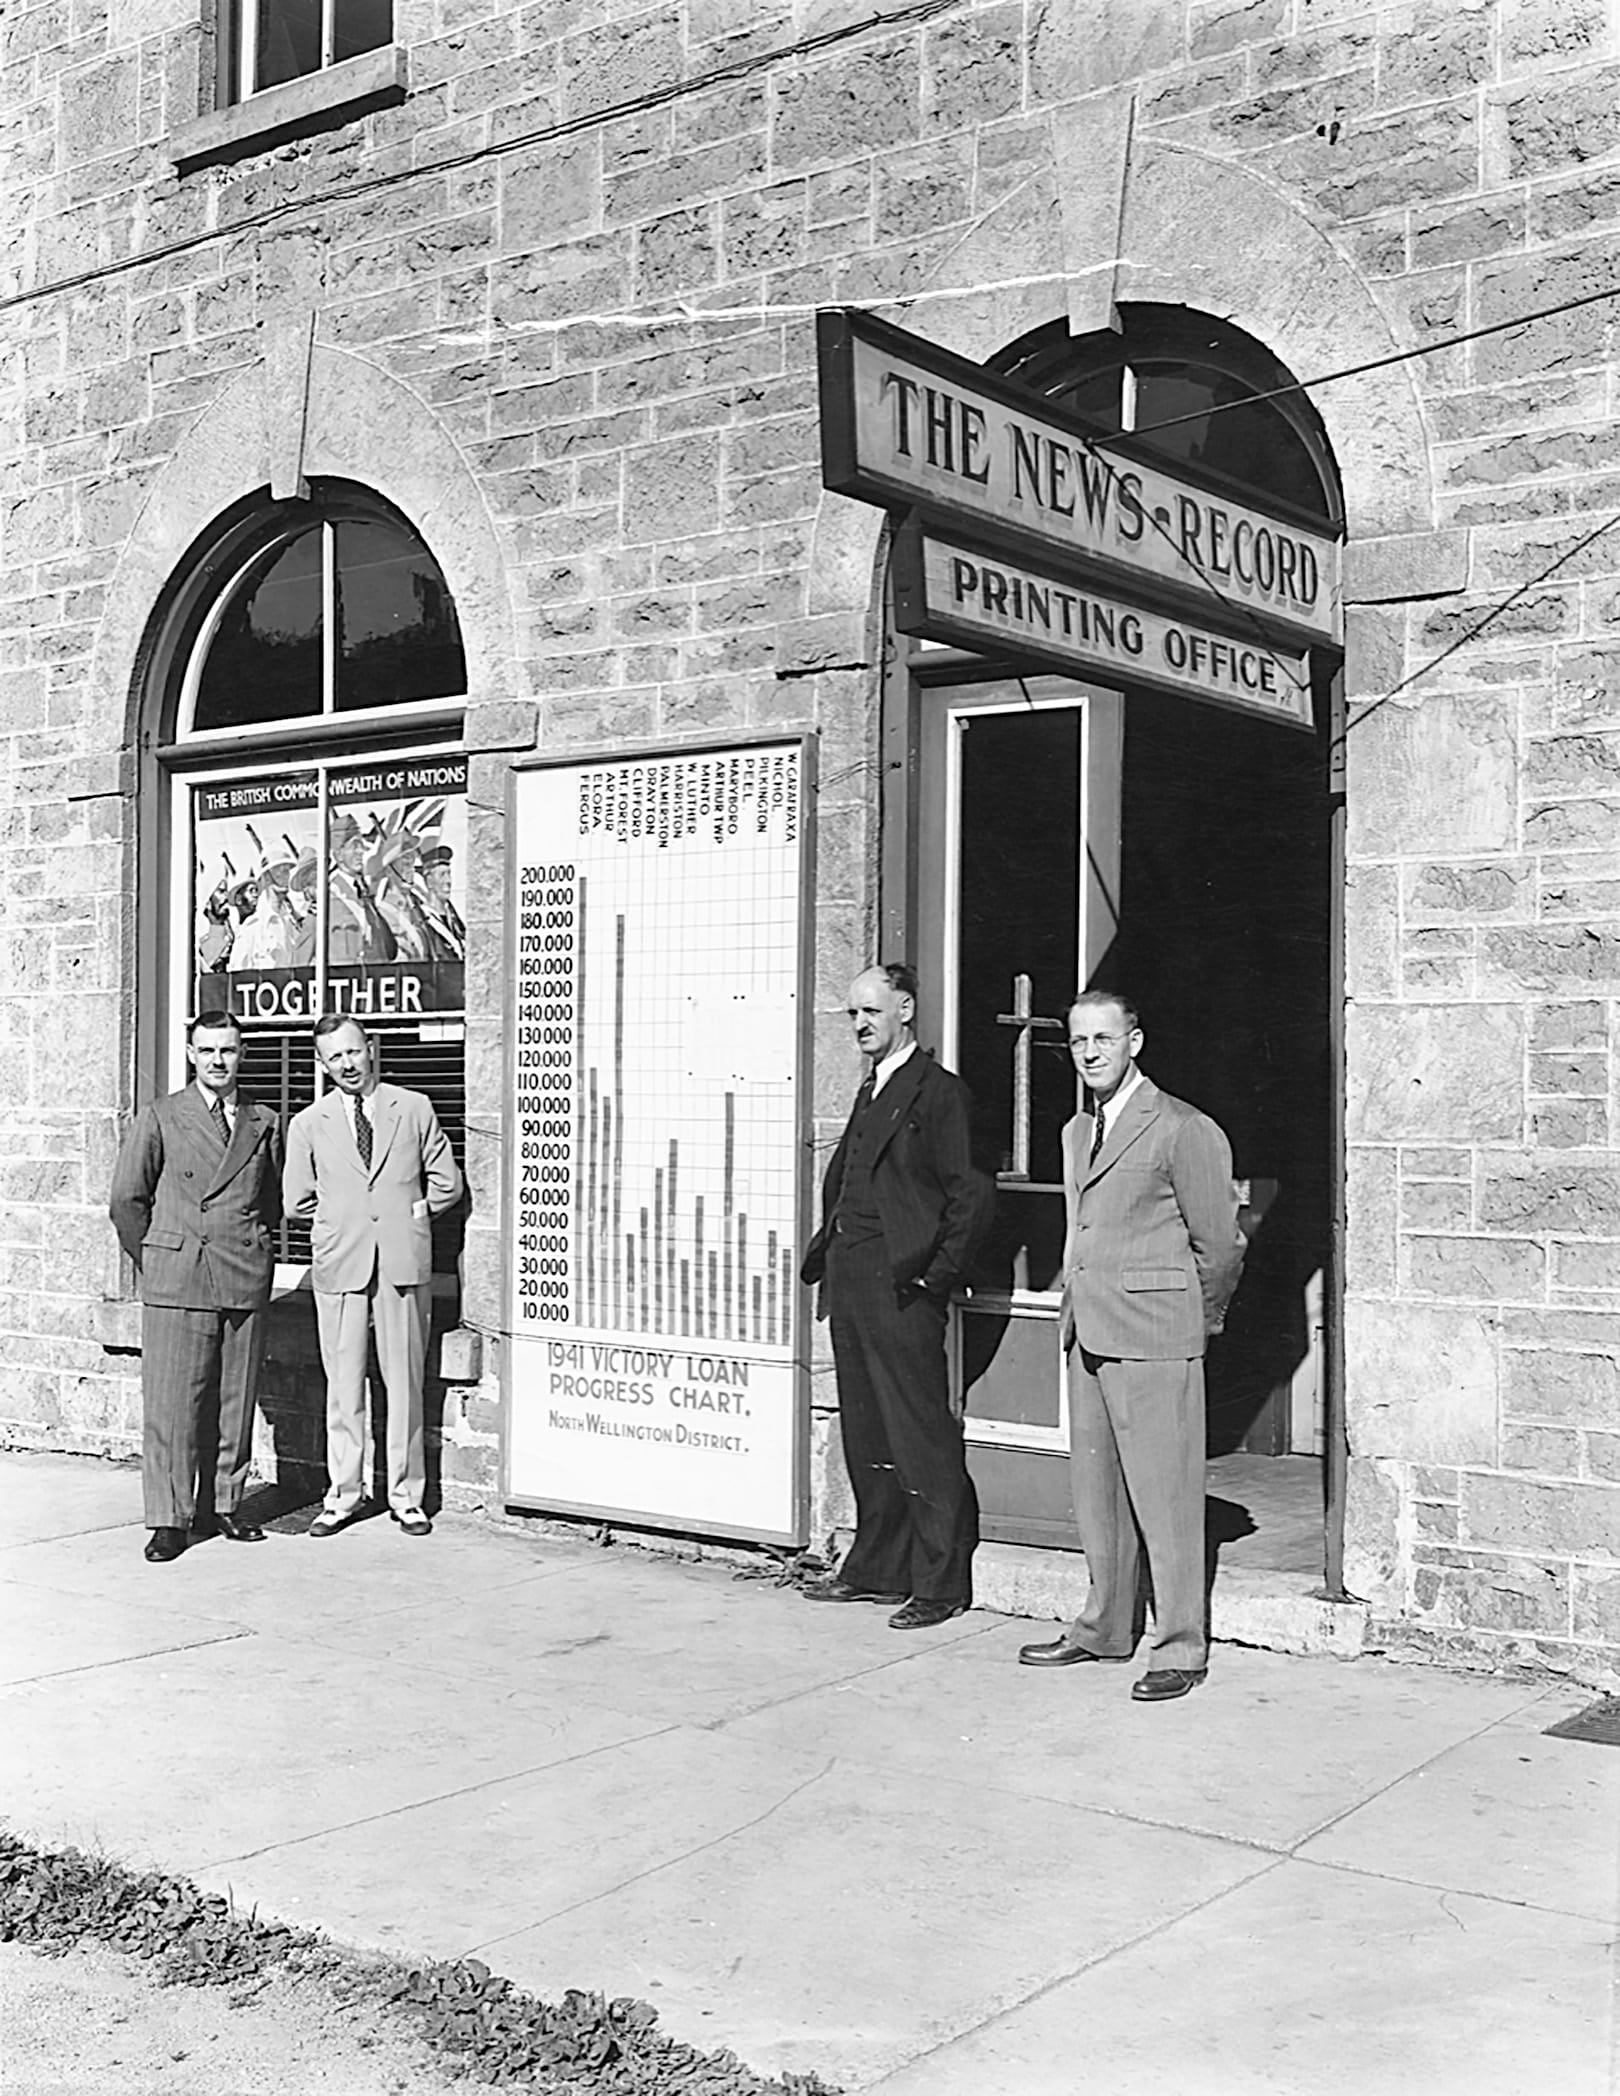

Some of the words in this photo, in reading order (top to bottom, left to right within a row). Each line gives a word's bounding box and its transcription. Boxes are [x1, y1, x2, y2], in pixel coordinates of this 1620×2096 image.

[880, 371, 990, 486] THE
[953, 557, 1144, 655] PRINTING
[1164, 628, 1278, 695] OFFICE
[206, 792, 229, 810] THE
[230, 787, 271, 807] BRITISH
[386, 772, 405, 790] OF
[407, 765, 466, 788] NATIONS
[699, 763, 711, 816] MINTO
[713, 760, 726, 813] ARTHUR
[727, 758, 740, 835] MARYBORO
[757, 756, 769, 833] PILKINGTON
[579, 774, 590, 835] FERGUS
[592, 773, 603, 829] ELORA
[604, 772, 616, 832] ARTHUR
[631, 767, 644, 838] CLIFFORD
[645, 767, 657, 835] DRAYTON
[658, 765, 671, 849] PALMERSTON
[672, 764, 684, 839] HARRISTON
[685, 779, 698, 835] LUTHER
[785, 767, 798, 842] GARAFRAXA
[713, 815, 725, 845] TWP
[520, 864, 575, 885] 200.000
[521, 887, 574, 908] 190.000
[520, 910, 574, 930] 180.000
[520, 933, 574, 953] 170.000
[519, 956, 574, 976] 160.000
[235, 975, 423, 1016] TOGETHER
[519, 980, 573, 999] 150.000
[518, 1003, 573, 1022] 140.000
[518, 1026, 573, 1045] 130.000
[518, 1049, 572, 1068] 120.000
[517, 1072, 572, 1091] 110.000
[517, 1095, 571, 1115] 100.000
[521, 1119, 571, 1138] 90.000
[521, 1141, 571, 1161] 80.000
[521, 1164, 570, 1184] 70.000
[519, 1186, 570, 1207] 60.000
[519, 1210, 569, 1230] 50.000
[518, 1233, 569, 1253] 40.000
[518, 1256, 569, 1277] 30.000
[518, 1278, 569, 1299] 20.000
[523, 1301, 570, 1323] 10.000
[547, 1341, 585, 1370] 1941
[591, 1346, 675, 1378] VICTORY
[687, 1356, 749, 1387] LOAN
[550, 1373, 655, 1406] PROGRESS
[668, 1385, 751, 1417] CHART.
